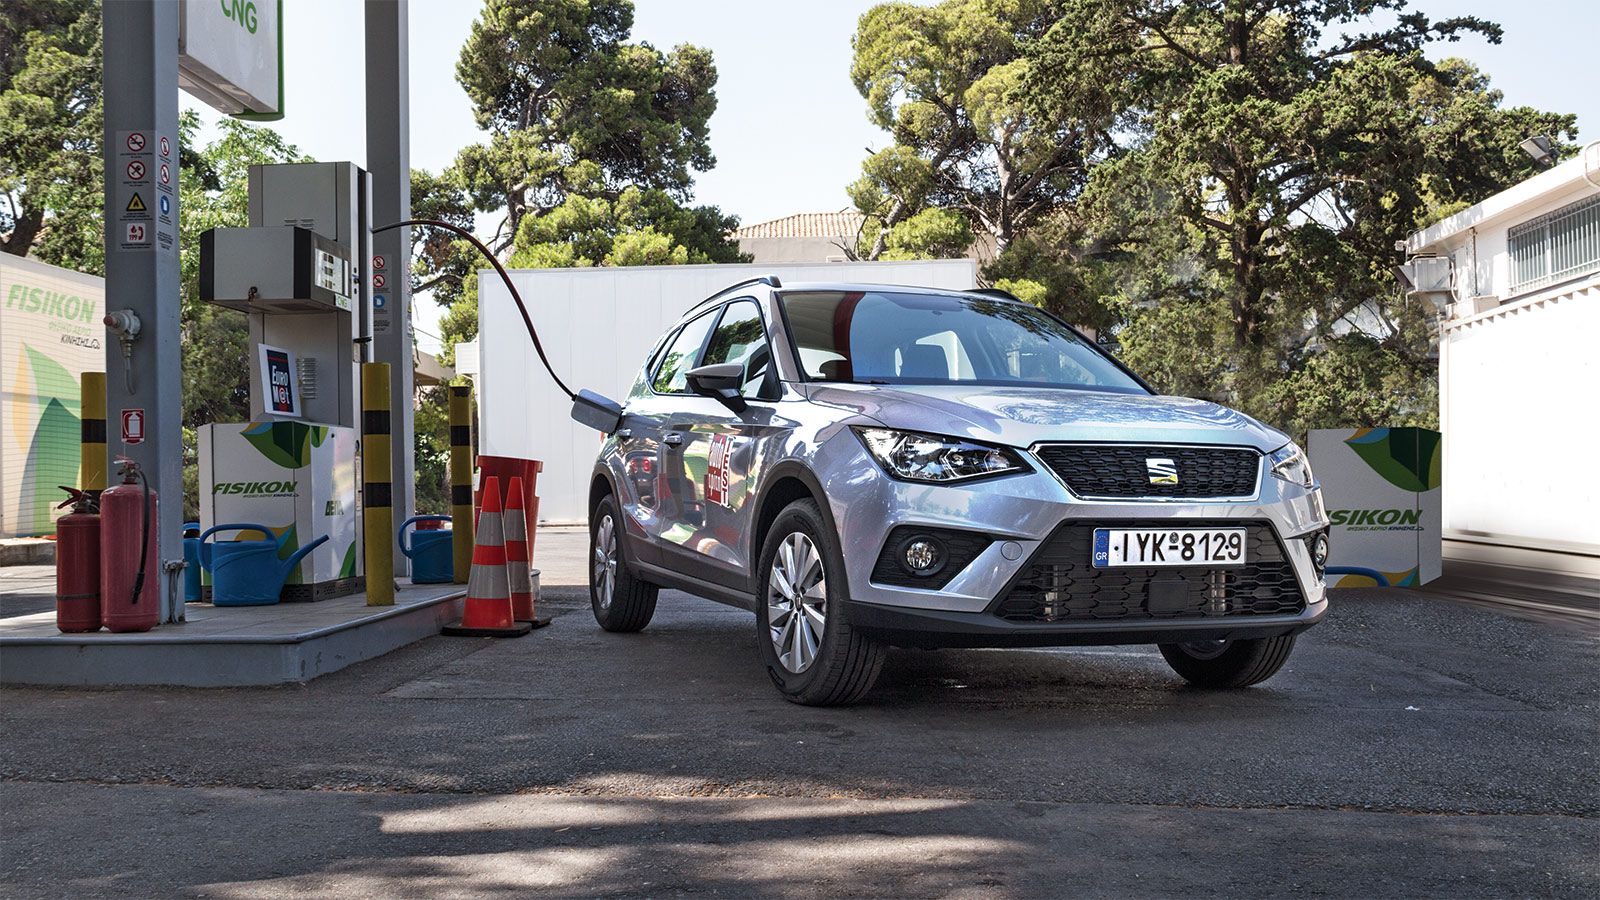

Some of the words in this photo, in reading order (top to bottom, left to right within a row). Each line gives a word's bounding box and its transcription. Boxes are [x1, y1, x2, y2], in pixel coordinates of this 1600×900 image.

[6, 284, 97, 323] FISIKON
[722, 437, 734, 504] TEST
[212, 481, 298, 495] FISIKON
[1326, 509, 1423, 526] SIKON
[1095, 551, 1107, 561] GR
